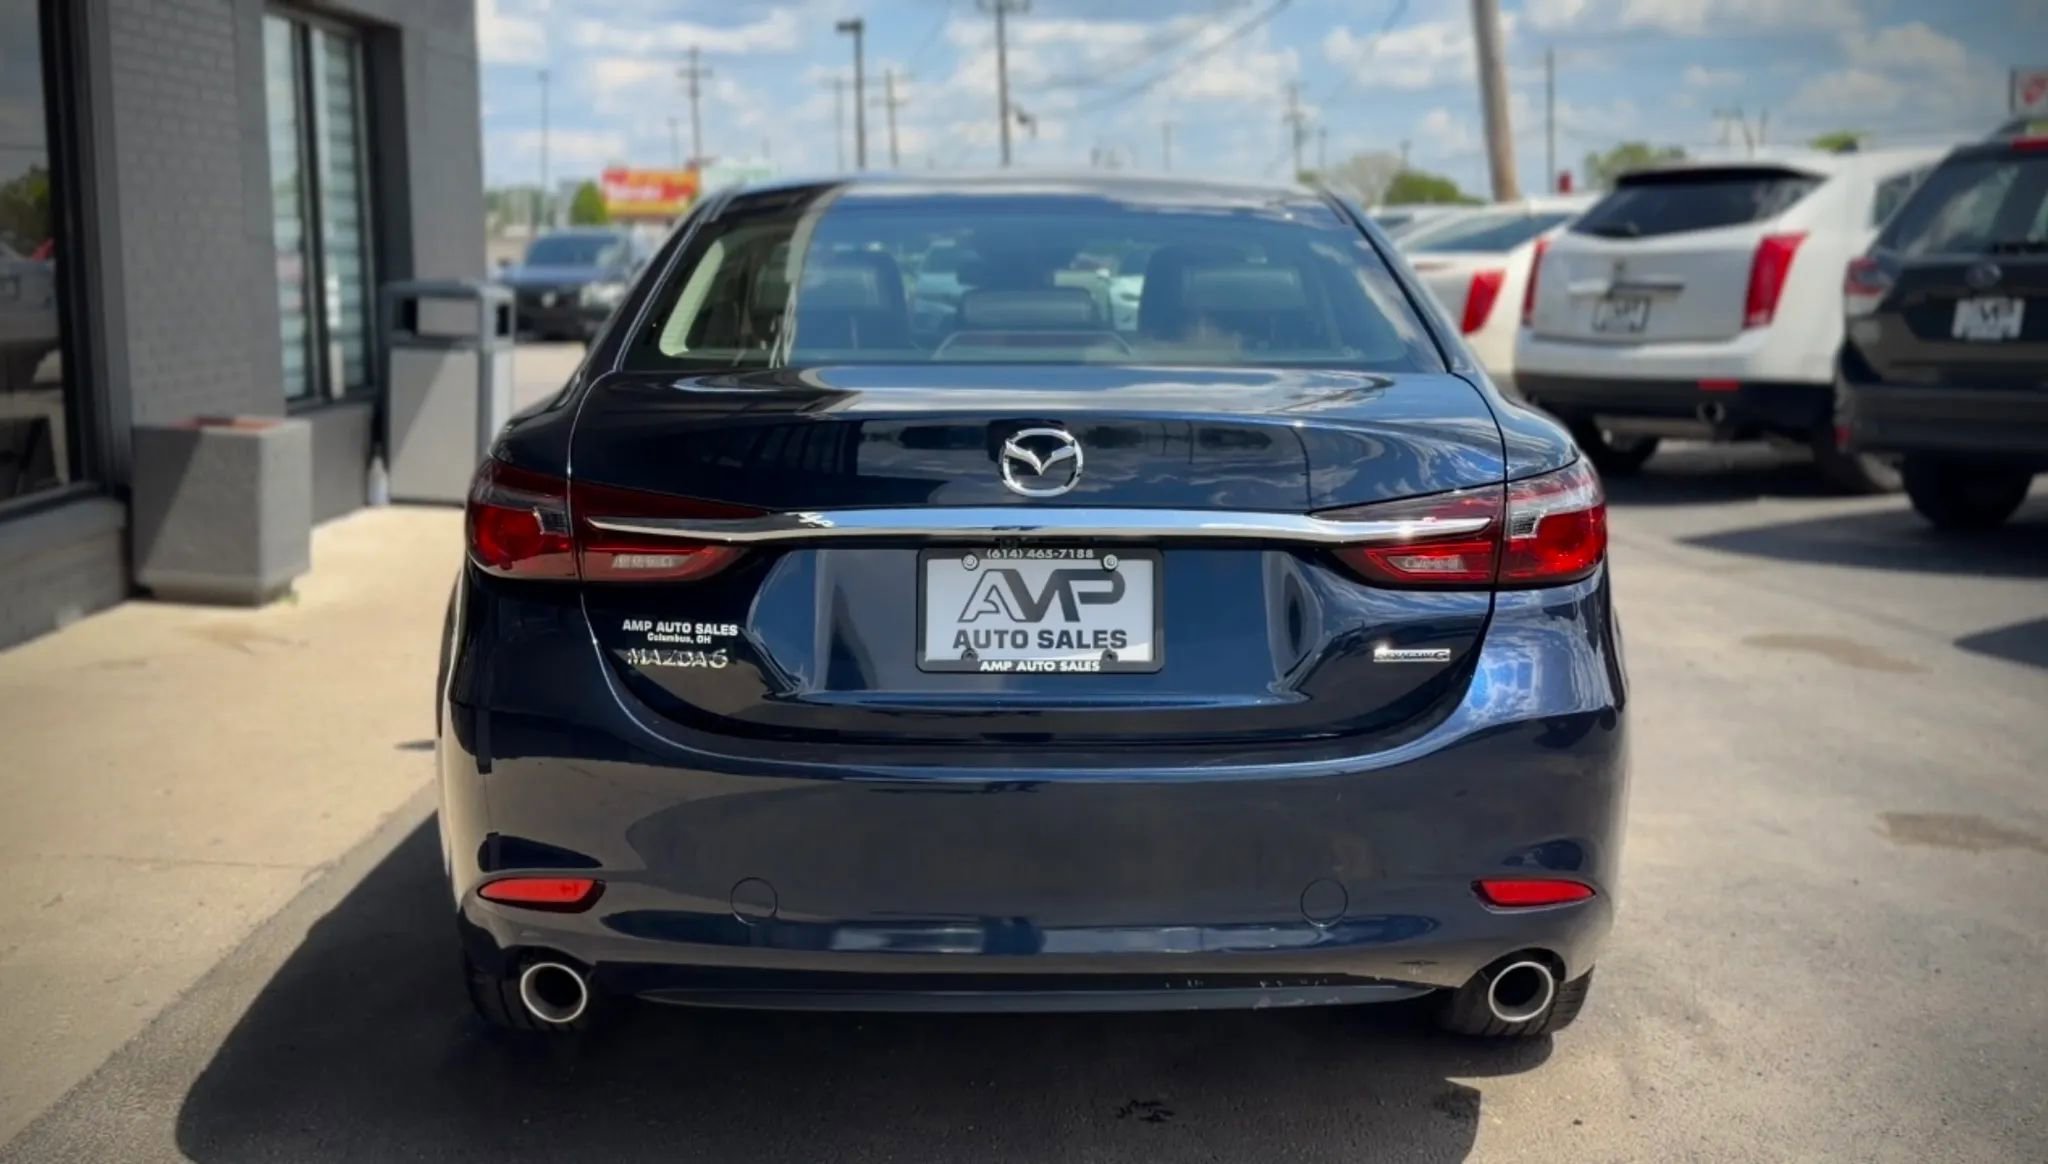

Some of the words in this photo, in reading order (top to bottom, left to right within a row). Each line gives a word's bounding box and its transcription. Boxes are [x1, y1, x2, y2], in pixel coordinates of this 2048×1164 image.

[987, 549, 1023, 559] (614)
[1027, 549, 1094, 559] 465-7188
[957, 569, 1126, 623] AMP
[622, 619, 652, 631] AMP
[656, 621, 692, 633] AUTO
[695, 623, 738, 636] SALES
[696, 634, 712, 644] OH
[953, 629, 1028, 649] AUTO
[1038, 629, 1127, 649] SALES
[980, 660, 1013, 672] AMP
[1016, 660, 1056, 672] AUTO
[1060, 660, 1100, 672] SALES
